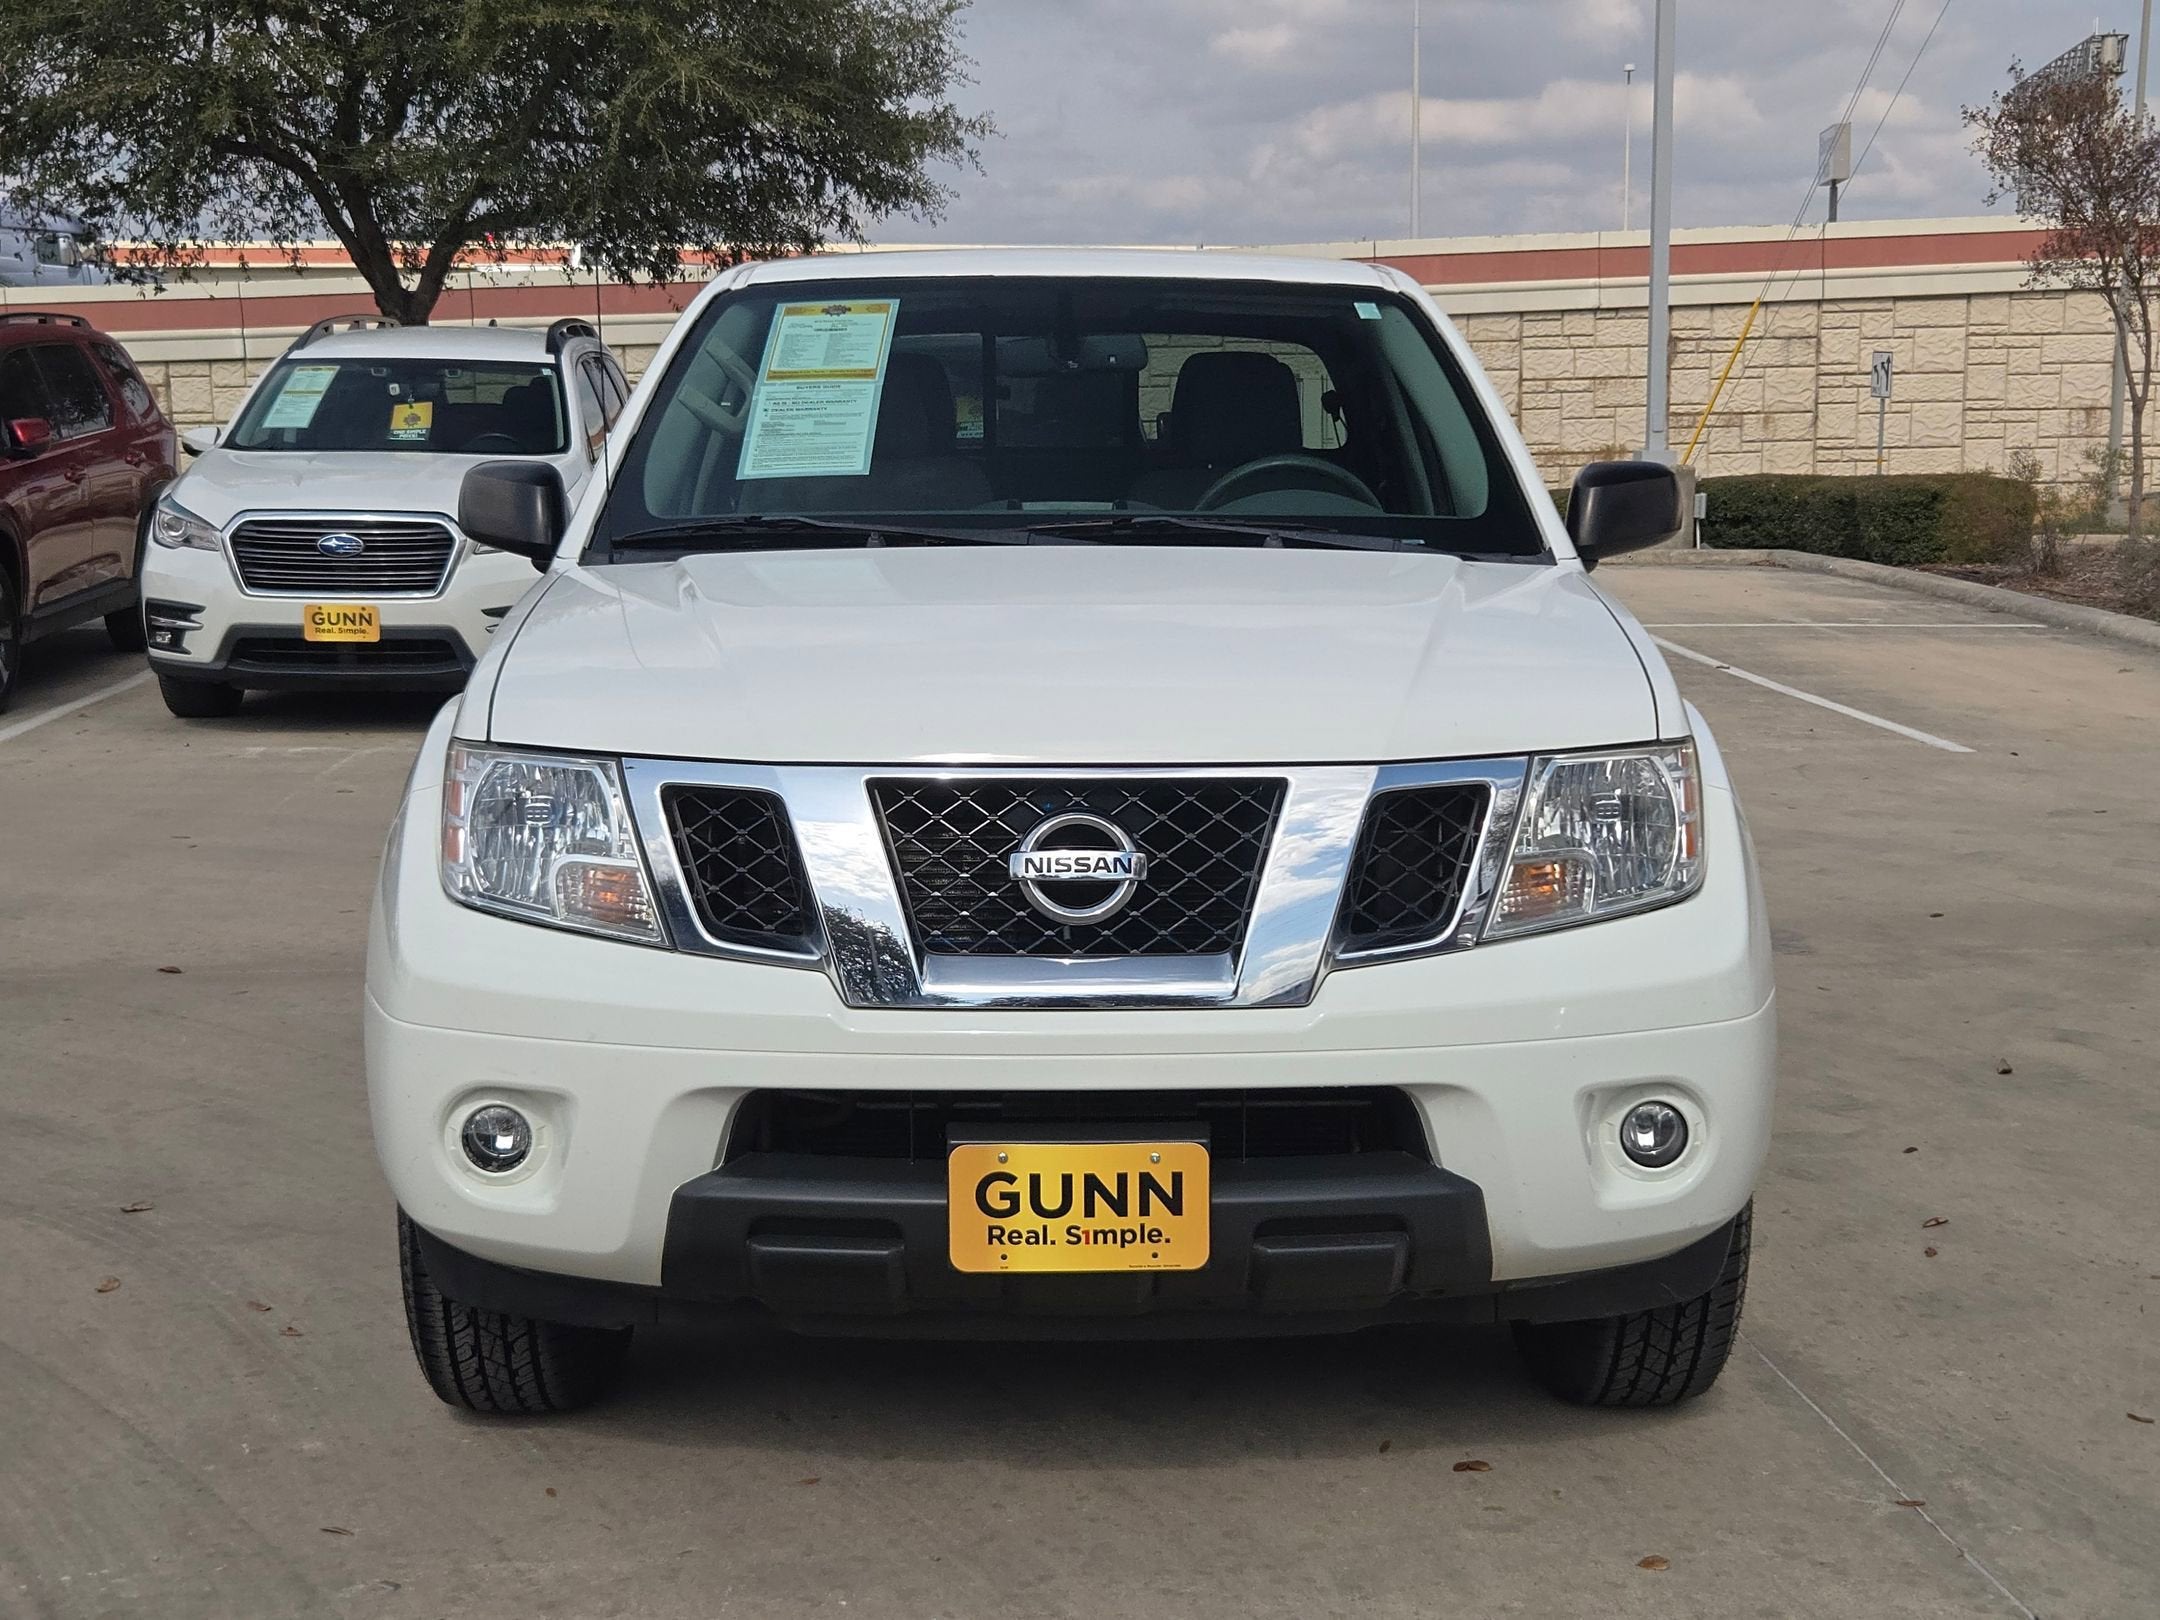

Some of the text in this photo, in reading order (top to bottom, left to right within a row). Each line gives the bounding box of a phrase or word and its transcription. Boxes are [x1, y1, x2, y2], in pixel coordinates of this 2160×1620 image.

[311, 611, 373, 626] GUNN
[1024, 856, 1132, 874] NISSAN
[974, 1170, 1183, 1219] GUNN
[987, 1224, 1056, 1246] Real.
